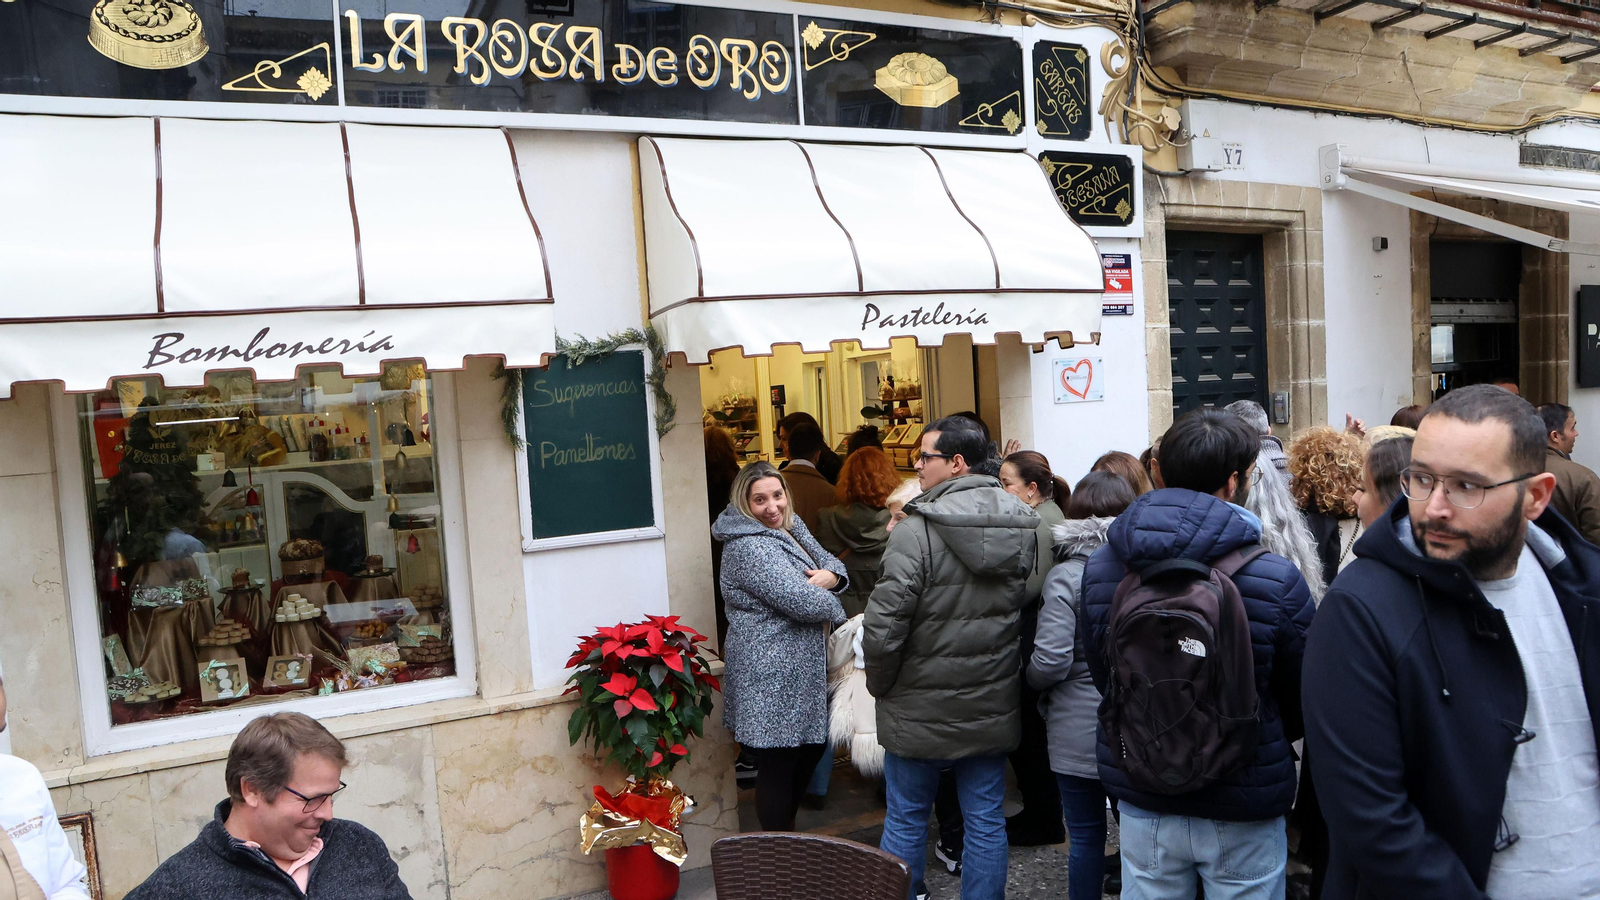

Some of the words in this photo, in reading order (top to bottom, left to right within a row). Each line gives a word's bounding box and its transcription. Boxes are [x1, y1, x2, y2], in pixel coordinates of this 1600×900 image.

[345, 9, 428, 74] LA
[441, 16, 604, 87] ROSA
[686, 34, 792, 101] ORO
[1058, 165, 1120, 213] RTESANA
[861, 301, 989, 331] Pastelería
[142, 326, 394, 370] Bombonería
[531, 379, 638, 418] Sugerencias
[149, 441, 177, 450] JEREZ
[540, 432, 637, 469] Panettones
